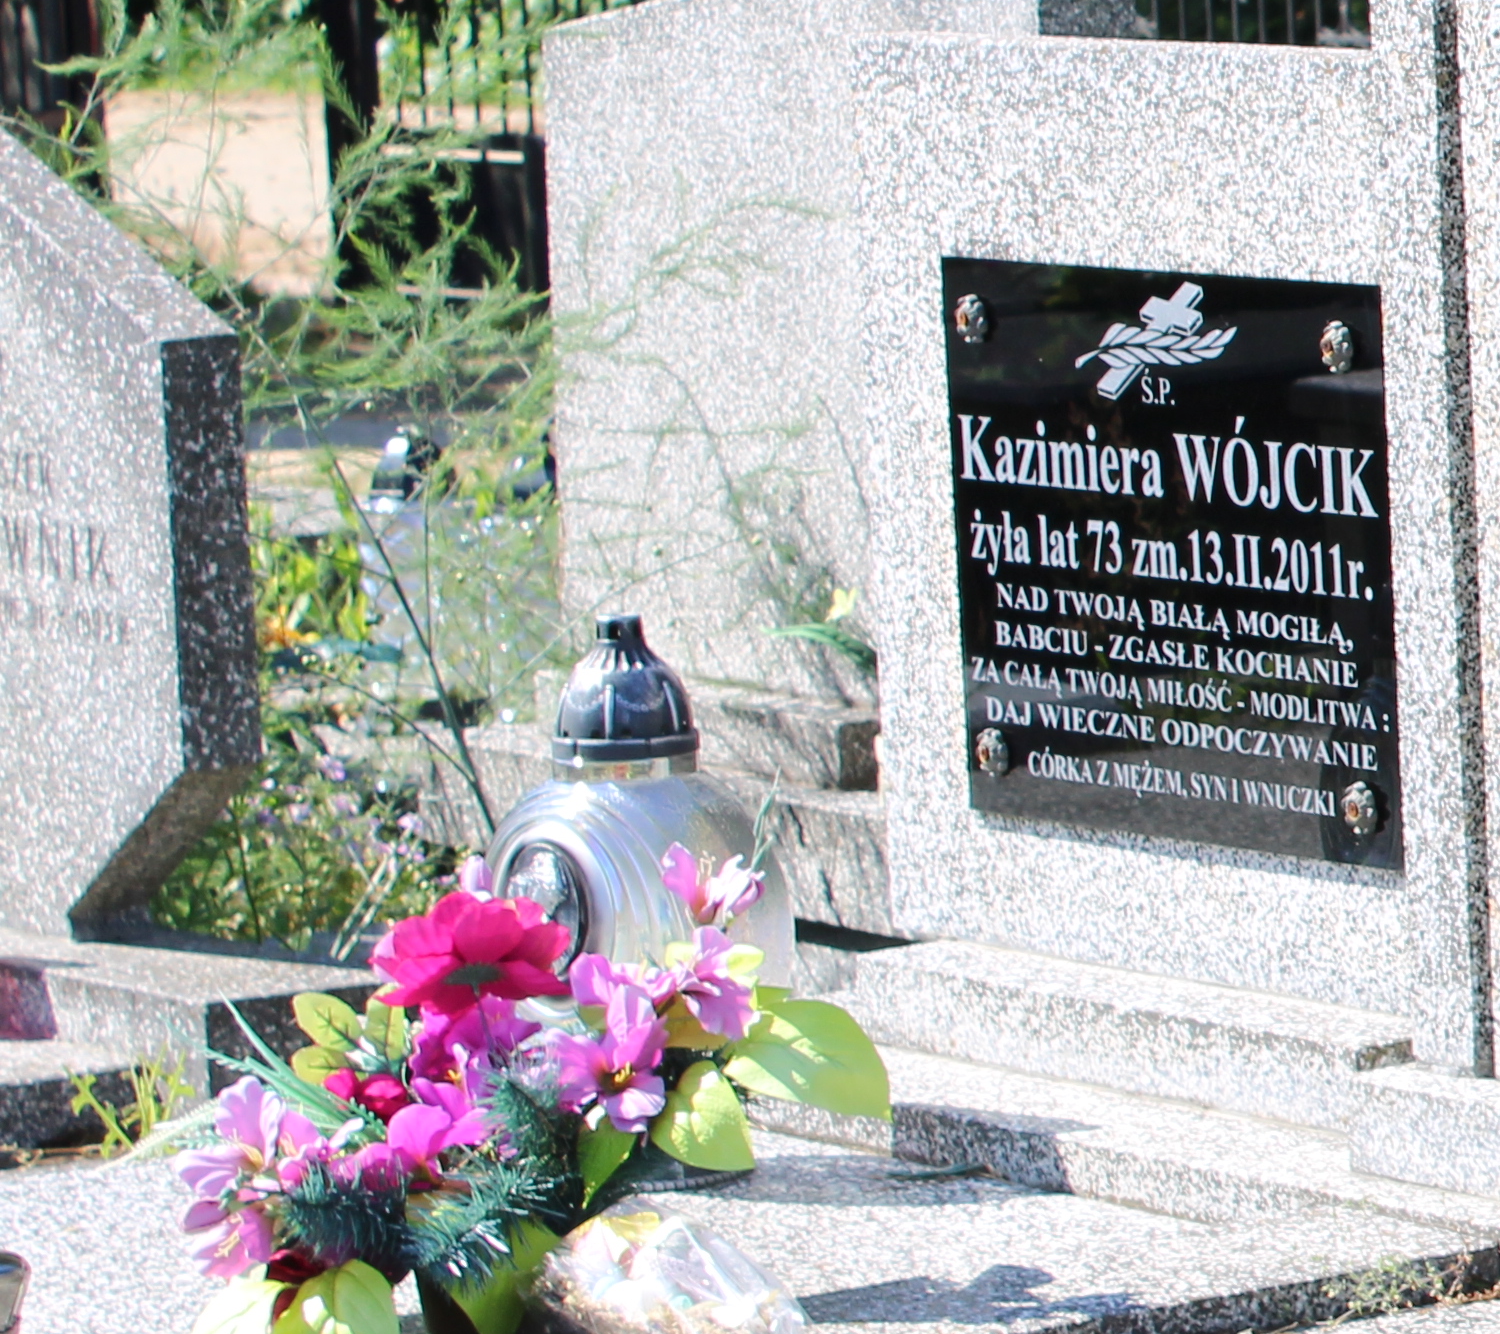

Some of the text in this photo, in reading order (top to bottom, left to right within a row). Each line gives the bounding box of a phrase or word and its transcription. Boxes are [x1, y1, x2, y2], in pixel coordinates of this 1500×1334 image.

[1141, 367, 1175, 406] Ś.P.
[957, 414, 1379, 518] Kazimiera WÓJCIK
[970, 508, 1031, 576] żyła
[1037, 514, 1079, 570] lat
[1086, 519, 1122, 574] 73
[995, 620, 1088, 656] BABCIU
[1109, 634, 1210, 671] ZGASŁE
[1216, 646, 1359, 688] KOCHANIE
[996, 582, 1354, 655] NAD TWOJĄ BIAŁĄ MOGIŁĄ,
[971, 656, 1001, 685] ZA
[1003, 660, 1063, 700] CAŁĄ
[1065, 667, 1143, 709] TWOJĄ
[1147, 677, 1232, 713] MIŁOŚĆ
[1250, 690, 1377, 731] MODLITWA
[985, 693, 1378, 772] DAJ WIECZNE ODPOCZYWANIE
[1027, 746, 1336, 817] CÓRKA Z MĘŻEM, SYN I WNUCZKI
